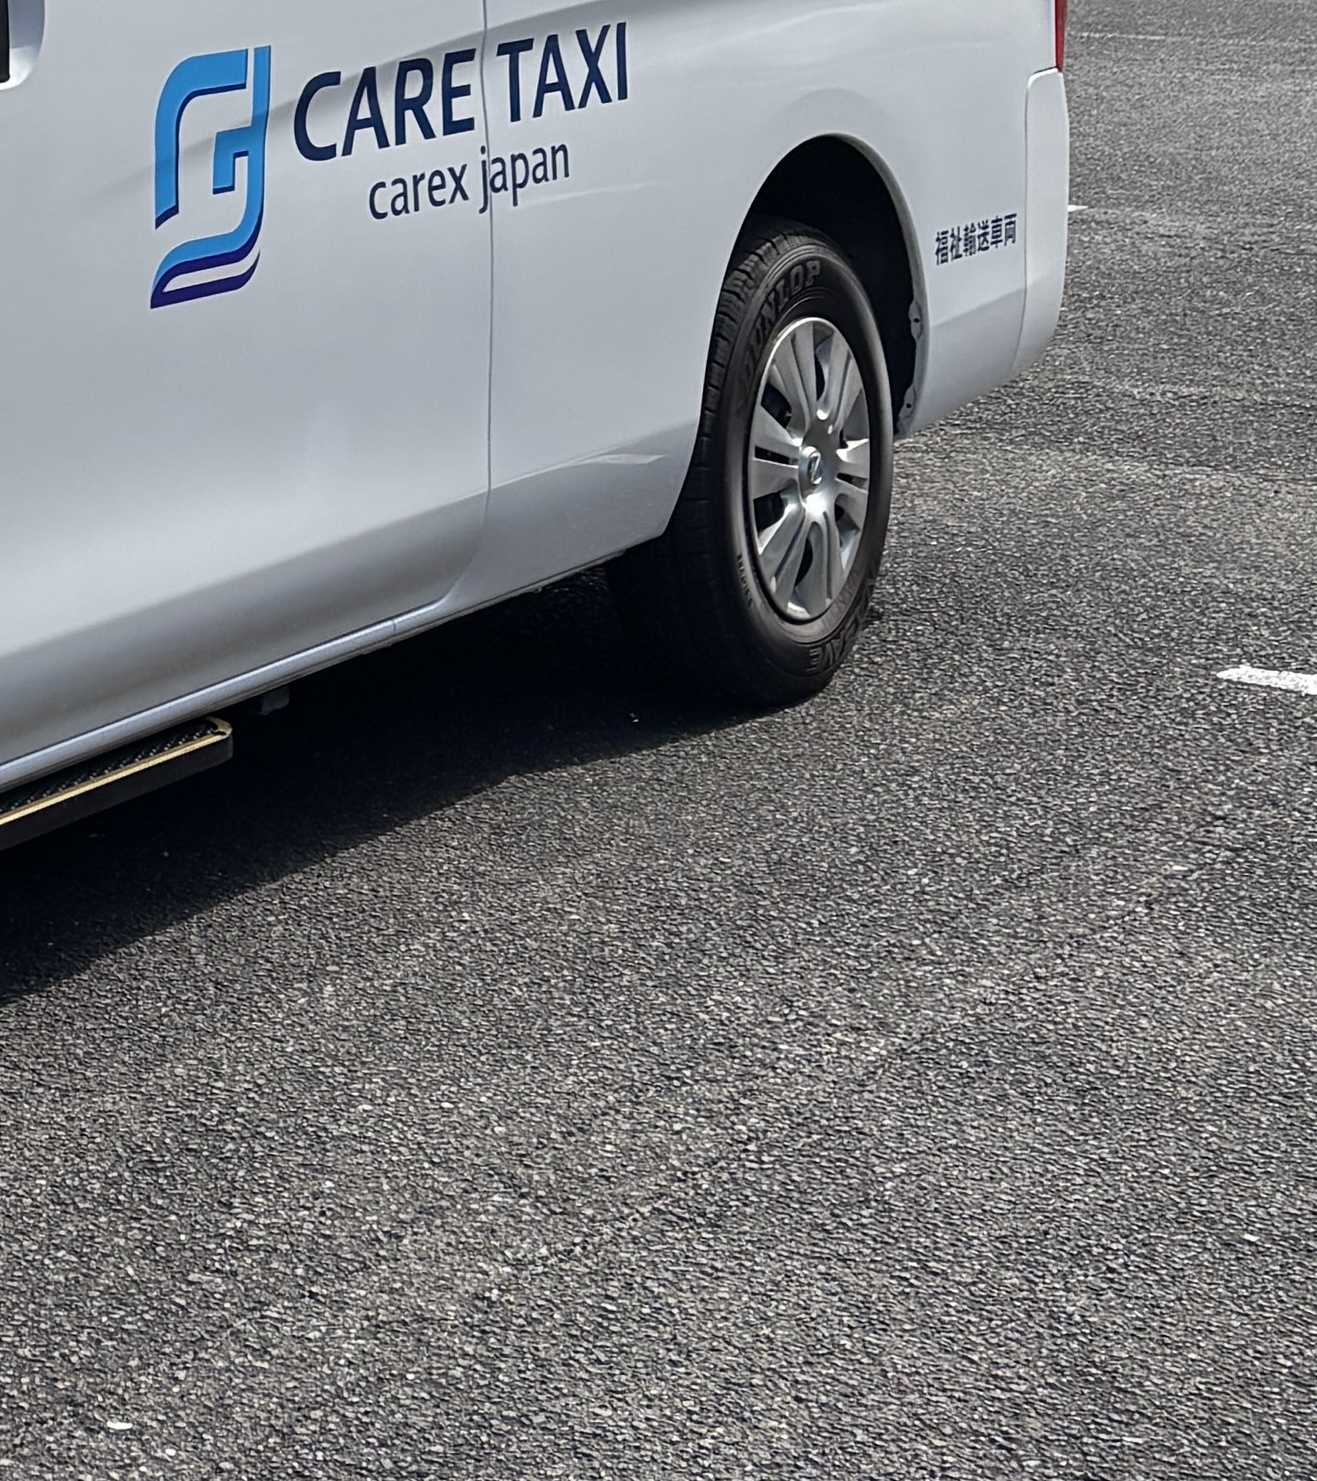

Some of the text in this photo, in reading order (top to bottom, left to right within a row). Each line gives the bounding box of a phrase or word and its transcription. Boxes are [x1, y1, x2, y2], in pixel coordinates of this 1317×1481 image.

[293, 21, 629, 161] CARE TAXI
[368, 142, 571, 220] carex japan
